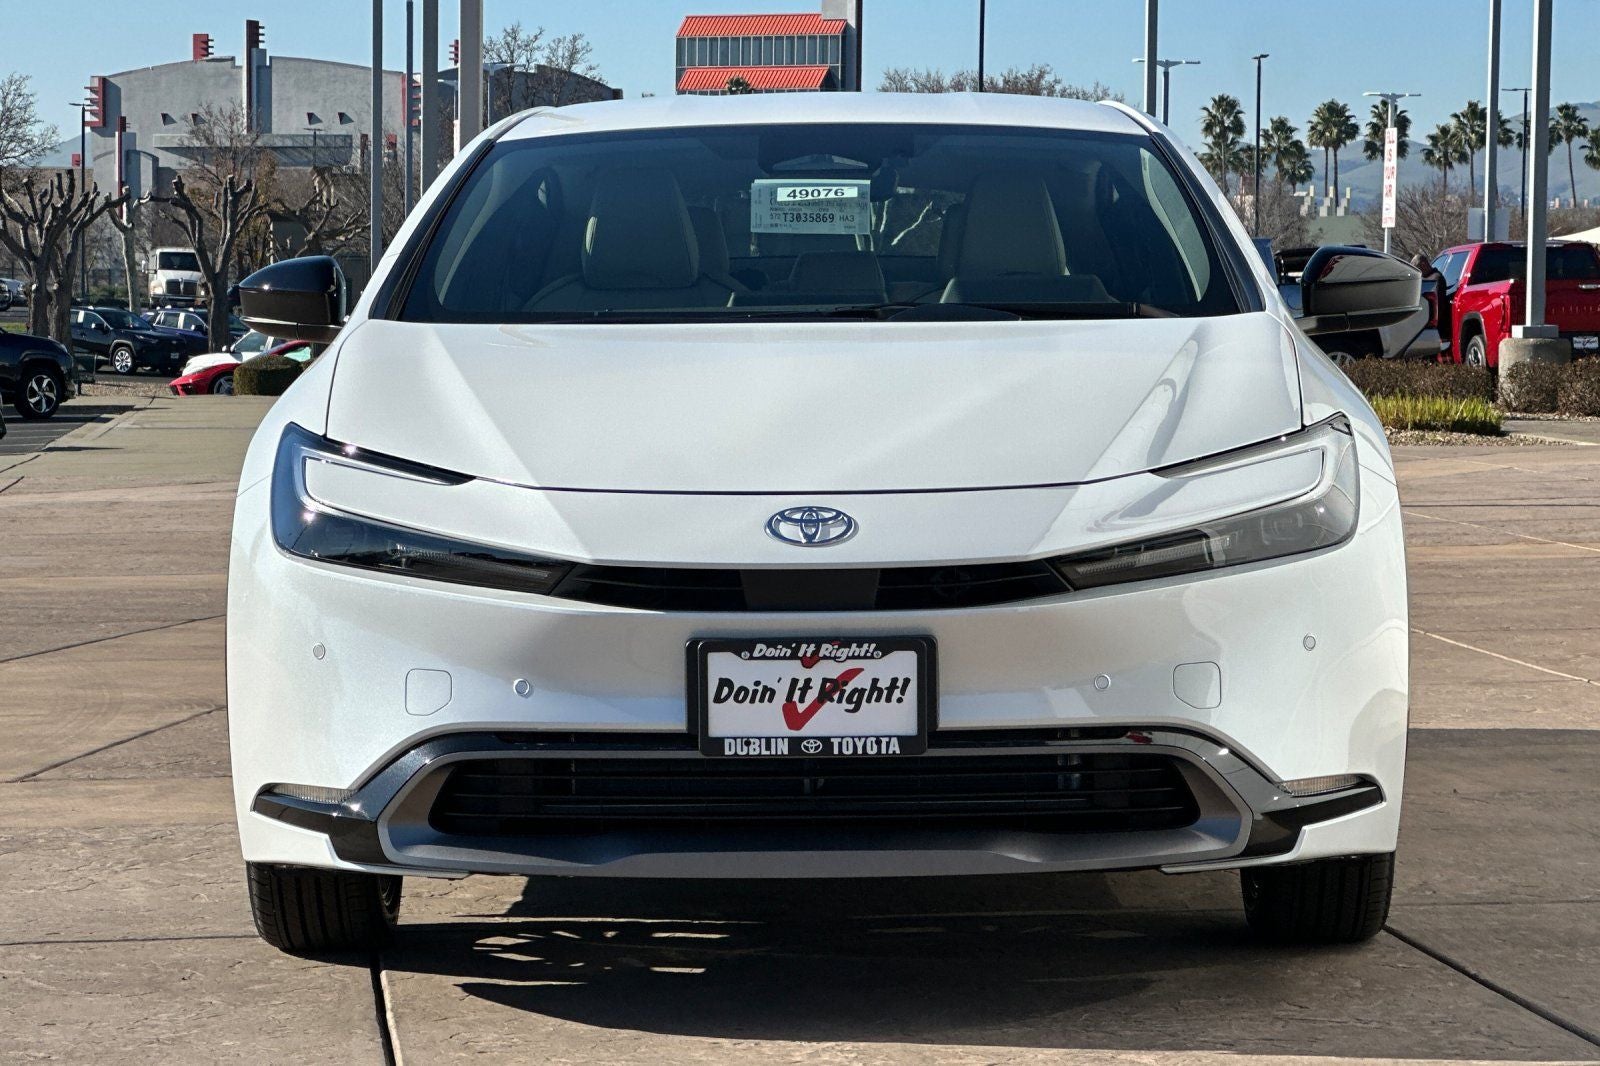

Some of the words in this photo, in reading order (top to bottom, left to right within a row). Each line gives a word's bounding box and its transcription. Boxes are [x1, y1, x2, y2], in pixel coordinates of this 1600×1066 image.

[787, 188, 845, 199] 49076
[783, 212, 835, 223] T3035869
[839, 213, 855, 221] HA3
[752, 643, 795, 658] Doin'
[797, 643, 816, 657] It
[818, 643, 873, 662] Right!
[712, 677, 782, 705] Doin'
[785, 678, 814, 704] It
[817, 677, 911, 713] Right!
[724, 737, 789, 755] DUBLIN
[830, 737, 901, 755] TOYOTA
